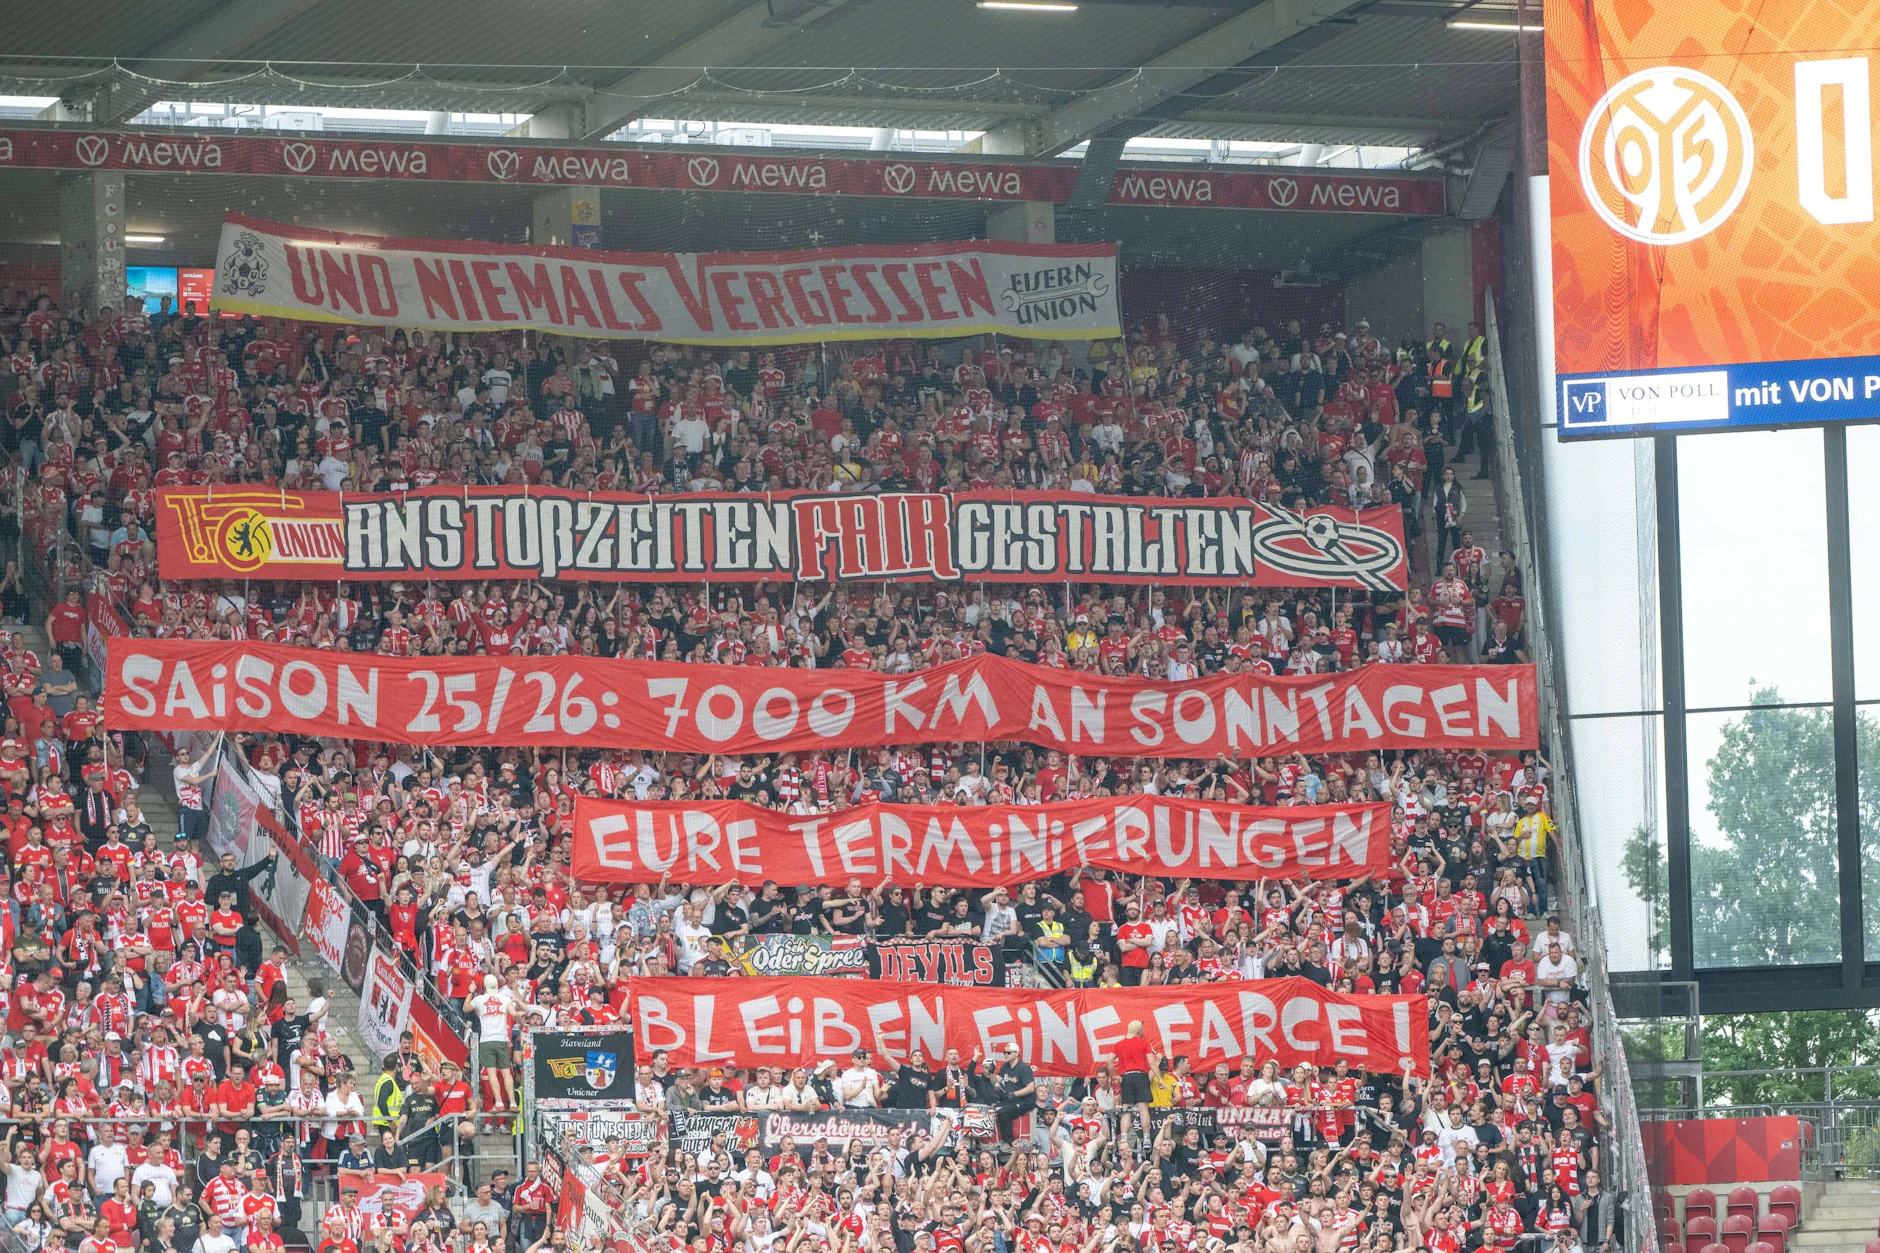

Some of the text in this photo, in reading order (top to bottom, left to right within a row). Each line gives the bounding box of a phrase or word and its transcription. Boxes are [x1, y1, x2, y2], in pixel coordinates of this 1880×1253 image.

[284, 244, 996, 332] UND NIEMALS VERGESSEN
[1010, 261, 1092, 294] EISERN
[1016, 294, 1097, 325] UNION
[1619, 383, 1720, 401] VON POLL
[1734, 380, 1782, 407] mit
[1788, 376, 1855, 404] VON
[271, 520, 345, 560] UNION
[793, 493, 962, 581] FAIR
[957, 500, 1255, 576] GESTALTEN
[406, 665, 622, 736] 25/26:
[646, 677, 856, 743] 7000
[884, 668, 1002, 735] KM
[1028, 684, 1108, 745] AN
[1129, 676, 1521, 748] SONNTAGEN
[588, 809, 763, 875] EURE
[752, 944, 865, 975] Oder Spree
[879, 943, 994, 984] DEVILS
[1185, 1110, 1213, 1127] Blut
[1216, 1108, 1295, 1125] UNIKAT
